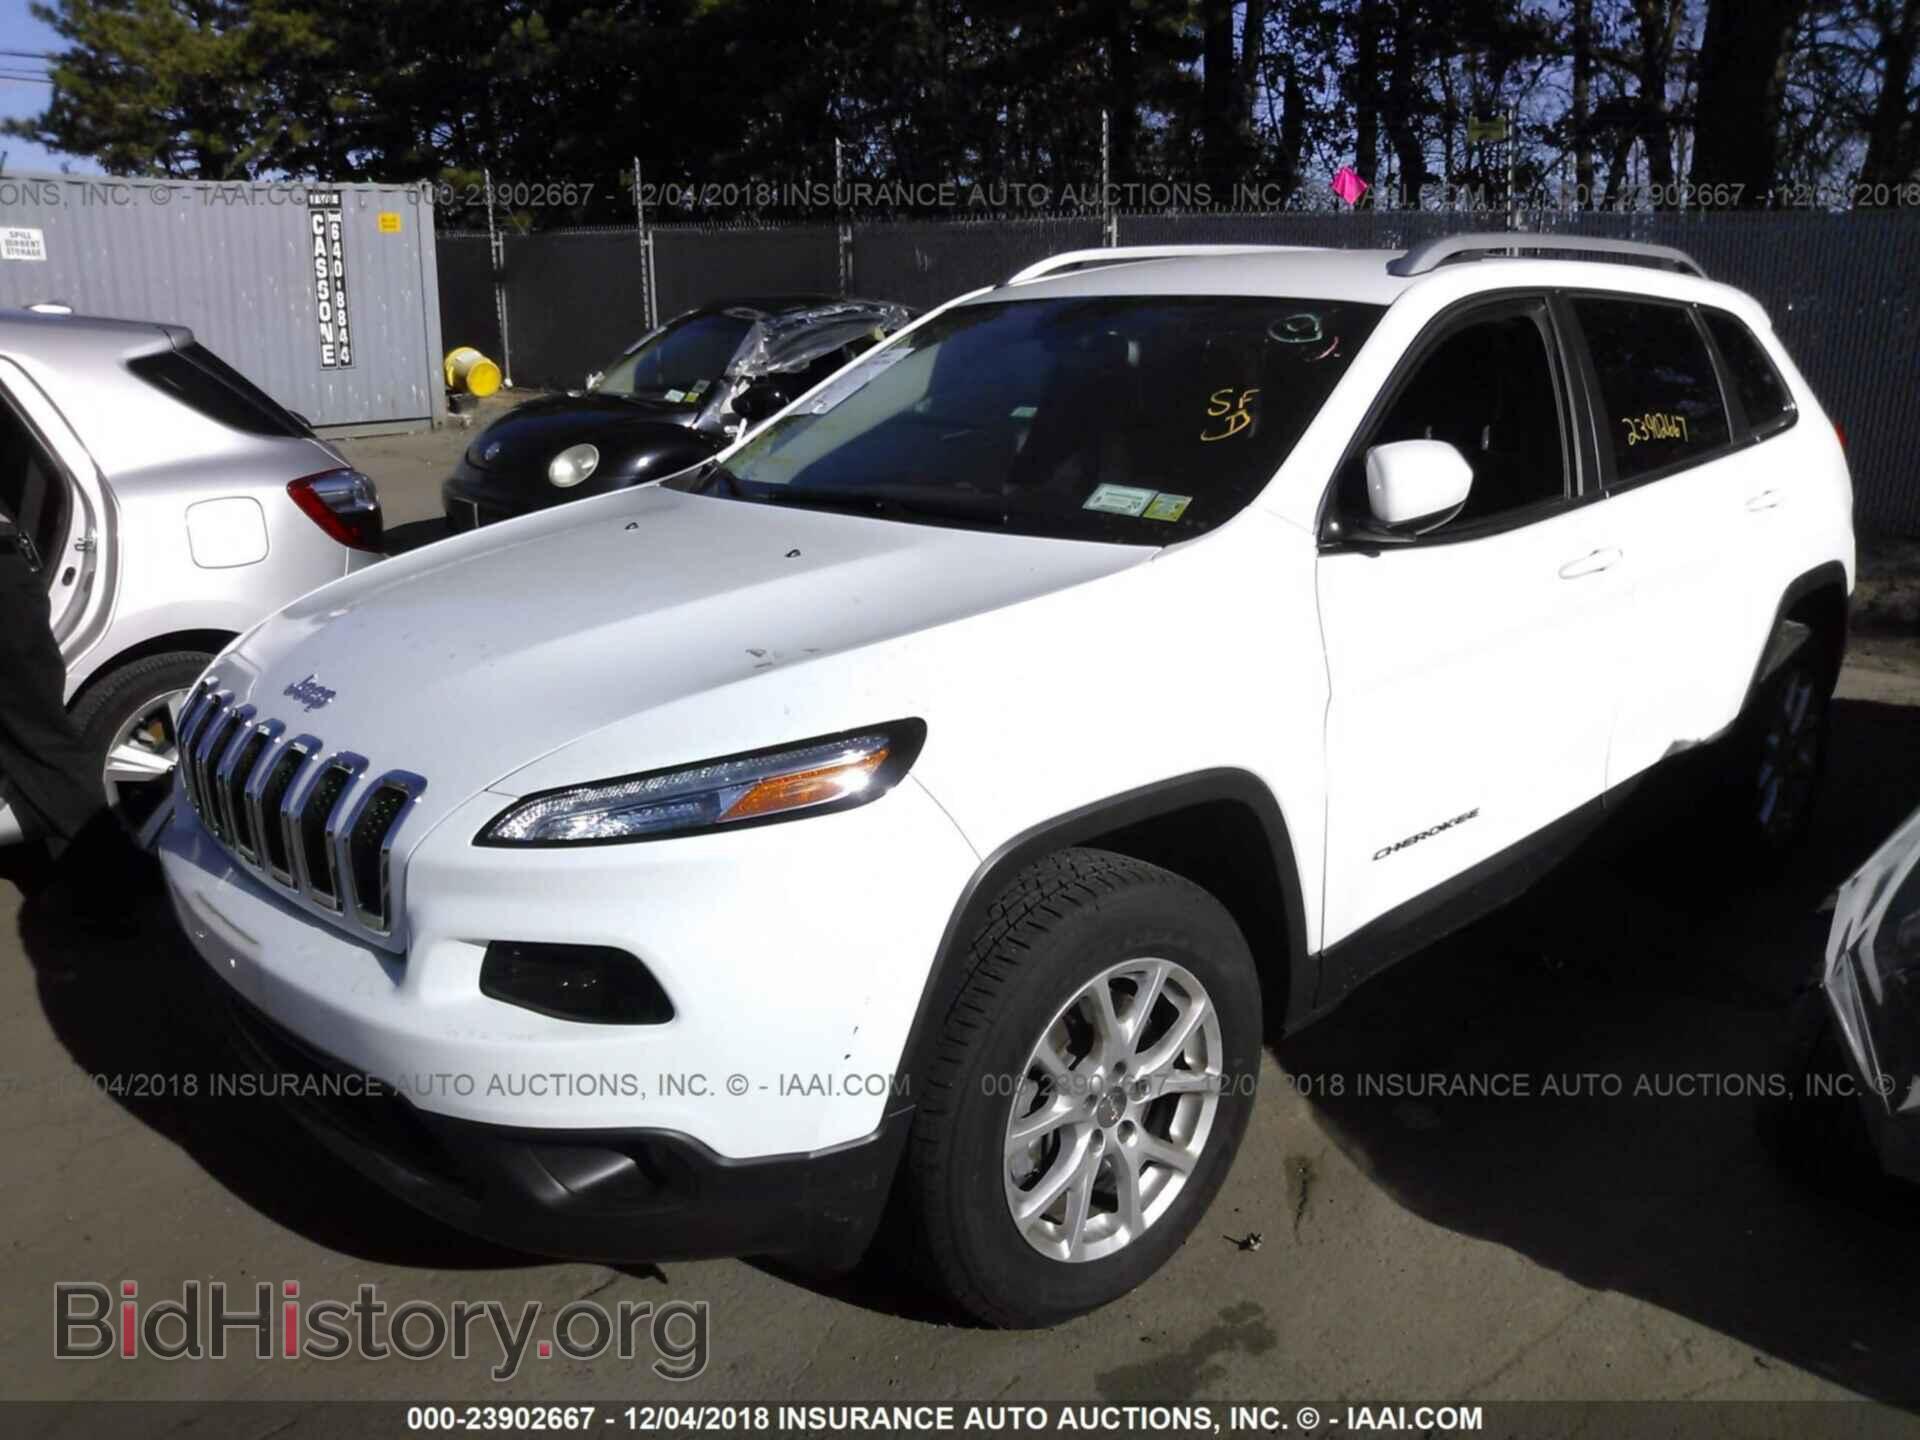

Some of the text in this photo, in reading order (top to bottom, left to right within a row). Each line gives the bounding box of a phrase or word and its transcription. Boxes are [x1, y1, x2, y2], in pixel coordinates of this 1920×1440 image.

[312, 213, 336, 365] CASSONE
[283, 674, 336, 712] Jeep
[1372, 807, 1480, 861] CHEROKEE
